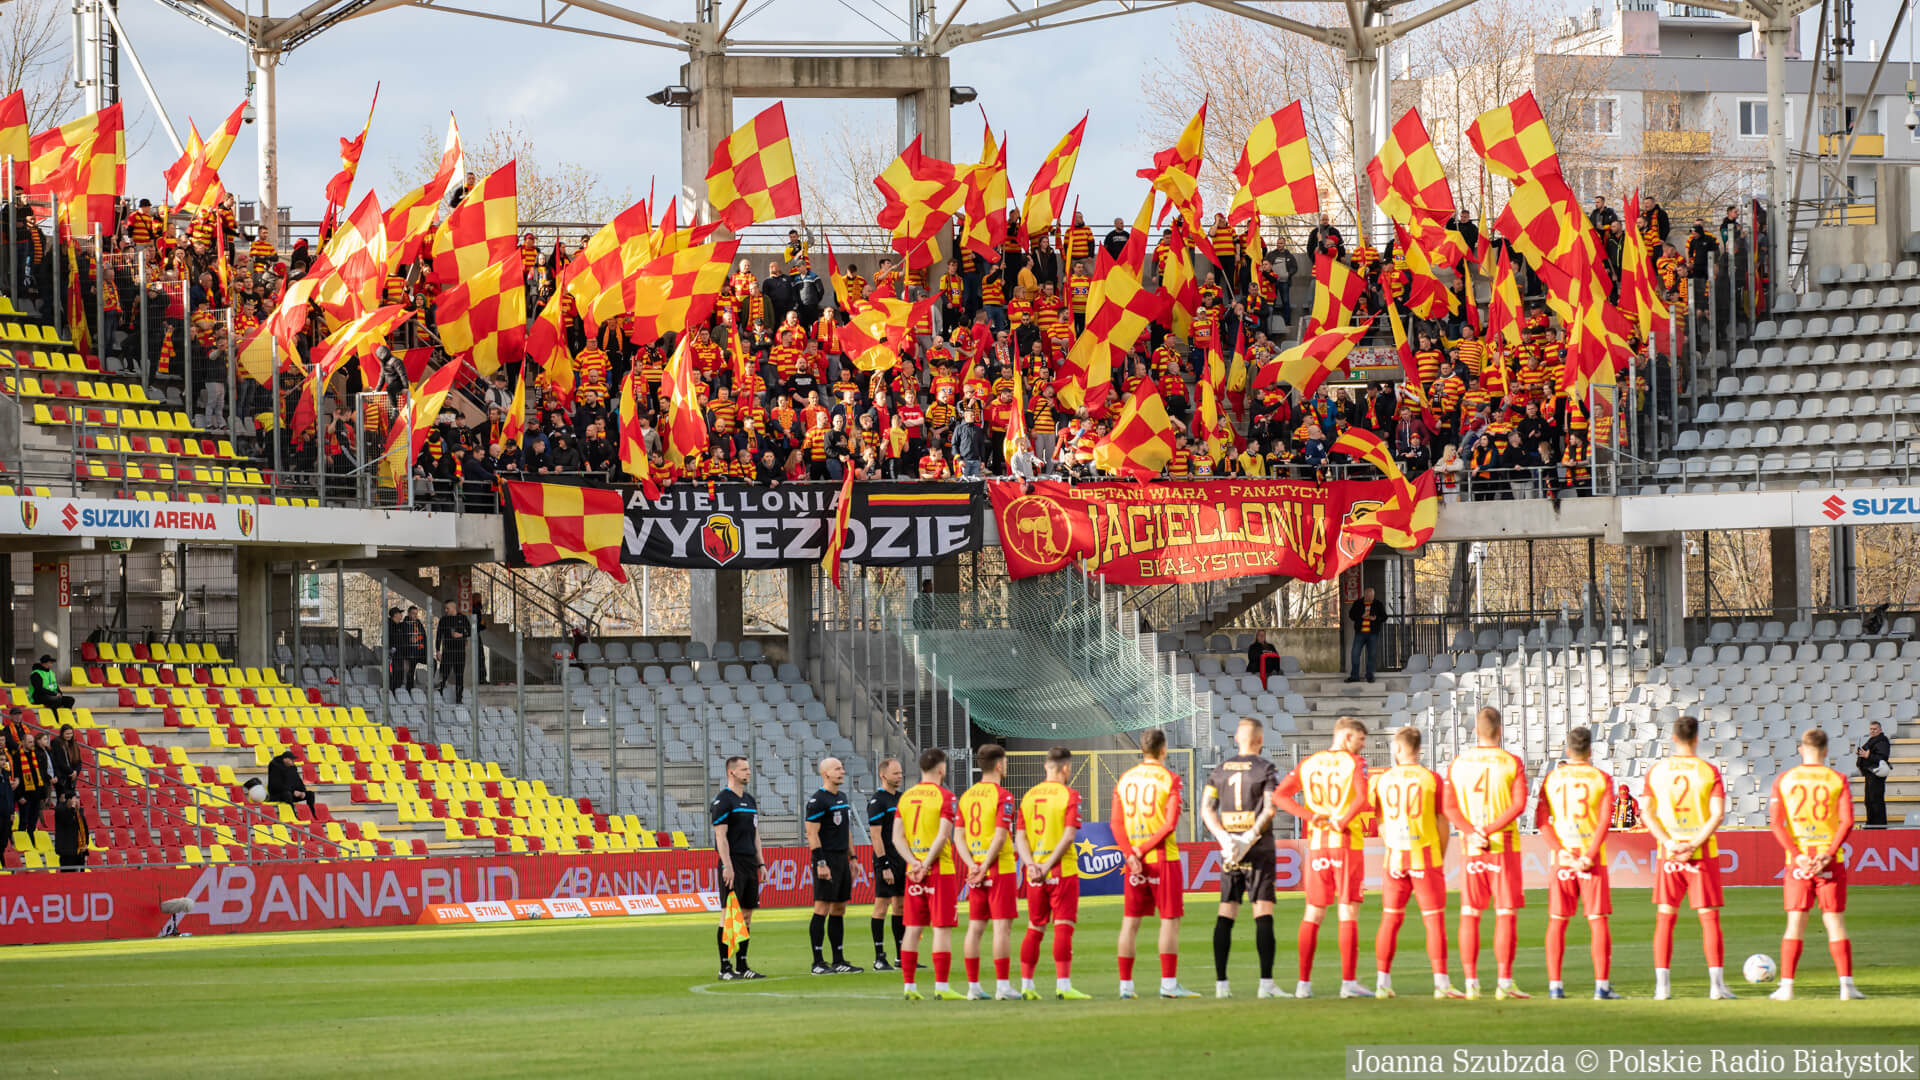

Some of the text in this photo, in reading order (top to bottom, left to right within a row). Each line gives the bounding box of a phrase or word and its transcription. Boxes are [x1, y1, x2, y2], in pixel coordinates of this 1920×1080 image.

[1229, 485, 1329, 499] FANATYCY!
[82, 508, 217, 530] SUZUKI ARENA
[1076, 500, 1328, 577] JAGIELLONIA
[1139, 550, 1279, 578] BIAŁYSTOK
[59, 563, 70, 606] B6D
[1125, 783, 1157, 818] 99
[1228, 771, 1242, 811] 1
[1309, 771, 1341, 807] 66
[1386, 783, 1422, 819] 90
[1474, 767, 1490, 805] 4
[1556, 783, 1590, 819] 13
[1673, 775, 1691, 812] 2
[1791, 785, 1830, 821] 28
[910, 799, 922, 835] 7
[969, 801, 981, 837] 8
[1033, 798, 1046, 835] 5
[594, 867, 720, 898] ANNA-BU
[436, 908, 469, 918] STIHL
[475, 905, 507, 916] STIHL
[552, 902, 582, 912] STIHL
[589, 900, 622, 911] STIHL
[628, 897, 660, 909] STIHL
[667, 896, 700, 908] STIHL
